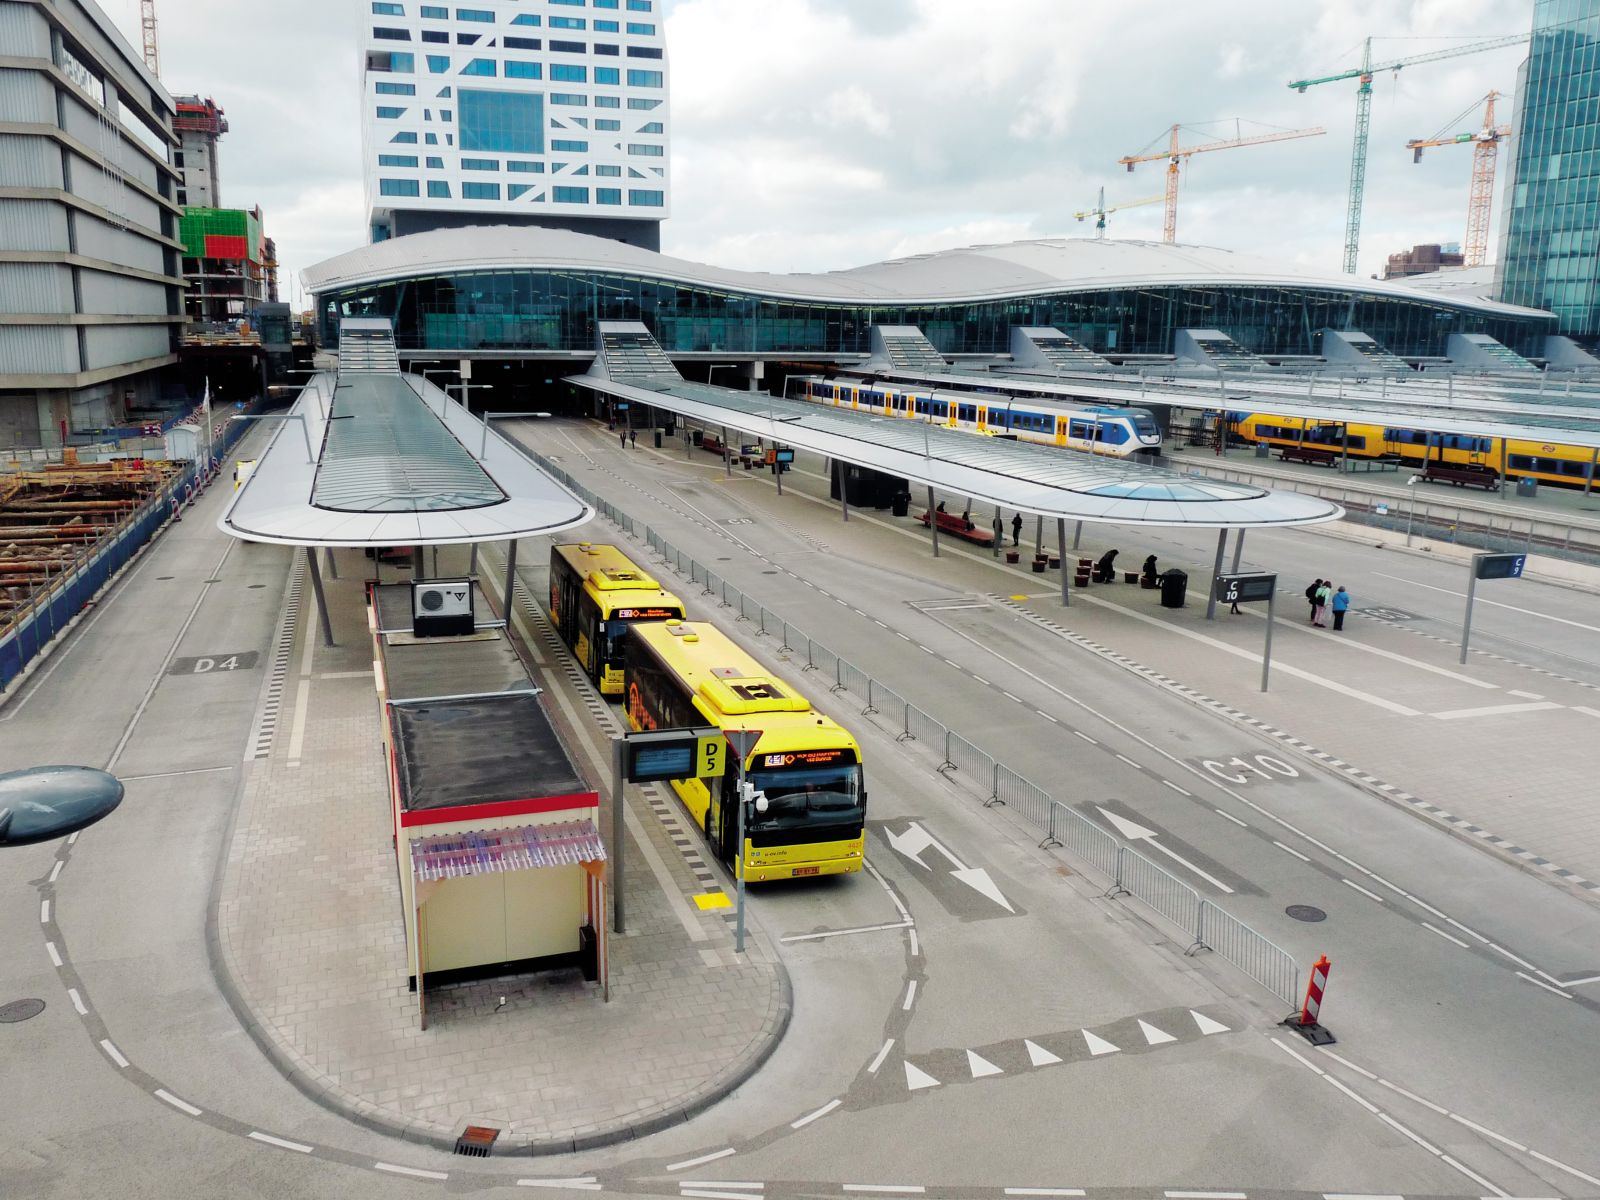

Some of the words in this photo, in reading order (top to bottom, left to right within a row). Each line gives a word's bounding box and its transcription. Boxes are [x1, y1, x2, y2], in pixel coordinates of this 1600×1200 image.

[1515, 558, 1523, 567] C
[1513, 566, 1520, 575] 9
[1230, 581, 1238, 590] C
[1226, 590, 1238, 600] 10
[705, 743, 718, 756] D
[706, 758, 716, 771] 5
[1202, 754, 1300, 784] C10
